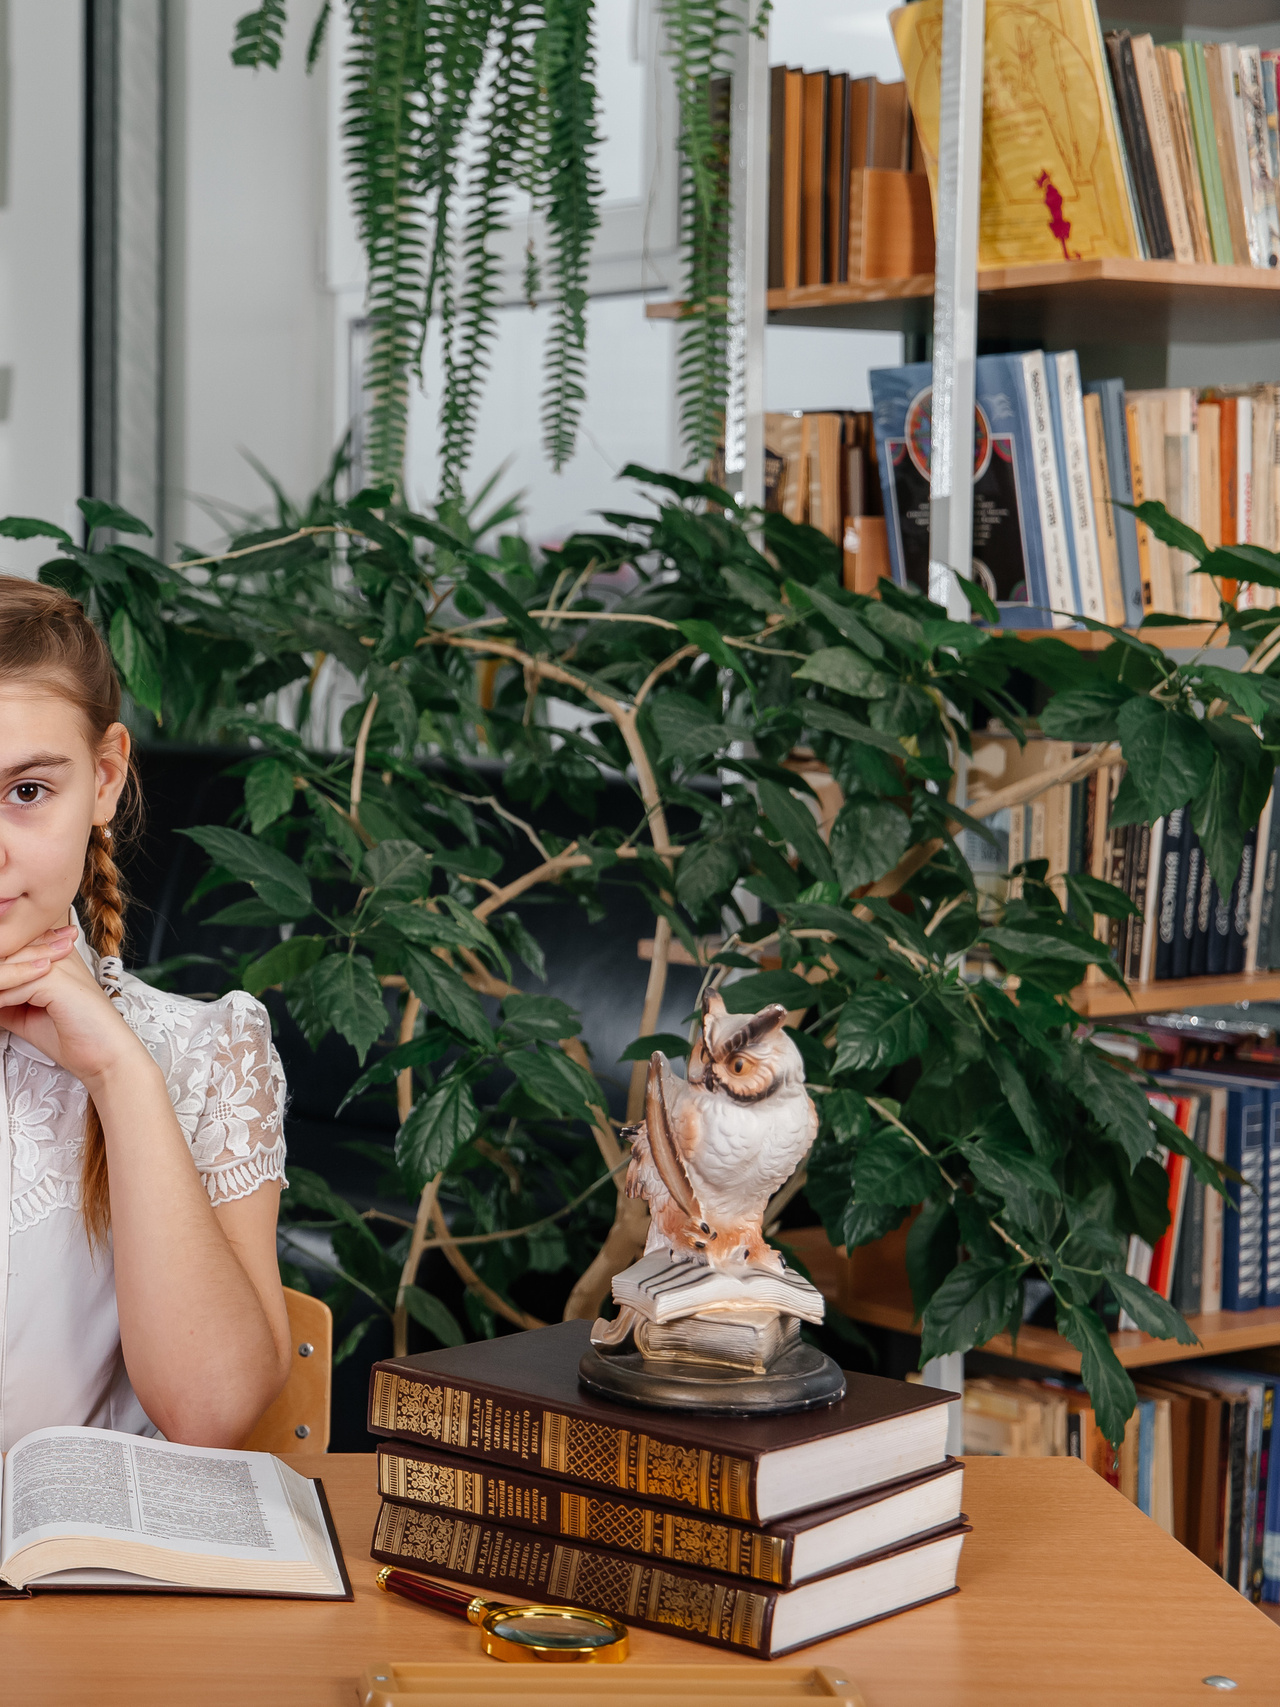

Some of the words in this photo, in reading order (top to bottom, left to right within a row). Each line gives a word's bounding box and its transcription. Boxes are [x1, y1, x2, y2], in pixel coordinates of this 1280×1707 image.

[484, 1399, 493, 1452] ТОЛКОВЫЙ
[494, 1406, 502, 1449] СЛОВАРЬ
[502, 1410, 512, 1450] ЖИВОГО
[512, 1410, 520, 1453] ВЕЛИКО-
[521, 1410, 530, 1460] РУССКОГО
[531, 1421, 539, 1454] ЯЗЫКА
[498, 1480, 506, 1518] ТОЛКОВЫЙ
[489, 1531, 504, 1578] ТОЛКОВЫЙ
[500, 1538, 512, 1576] СЛОВАРЬ
[508, 1542, 521, 1578] ЖИВОГО
[519, 1542, 530, 1580] ВЕЛИКО-
[527, 1542, 541, 1586] РУССКОГО
[538, 1552, 550, 1582] ЯЗЫКА
